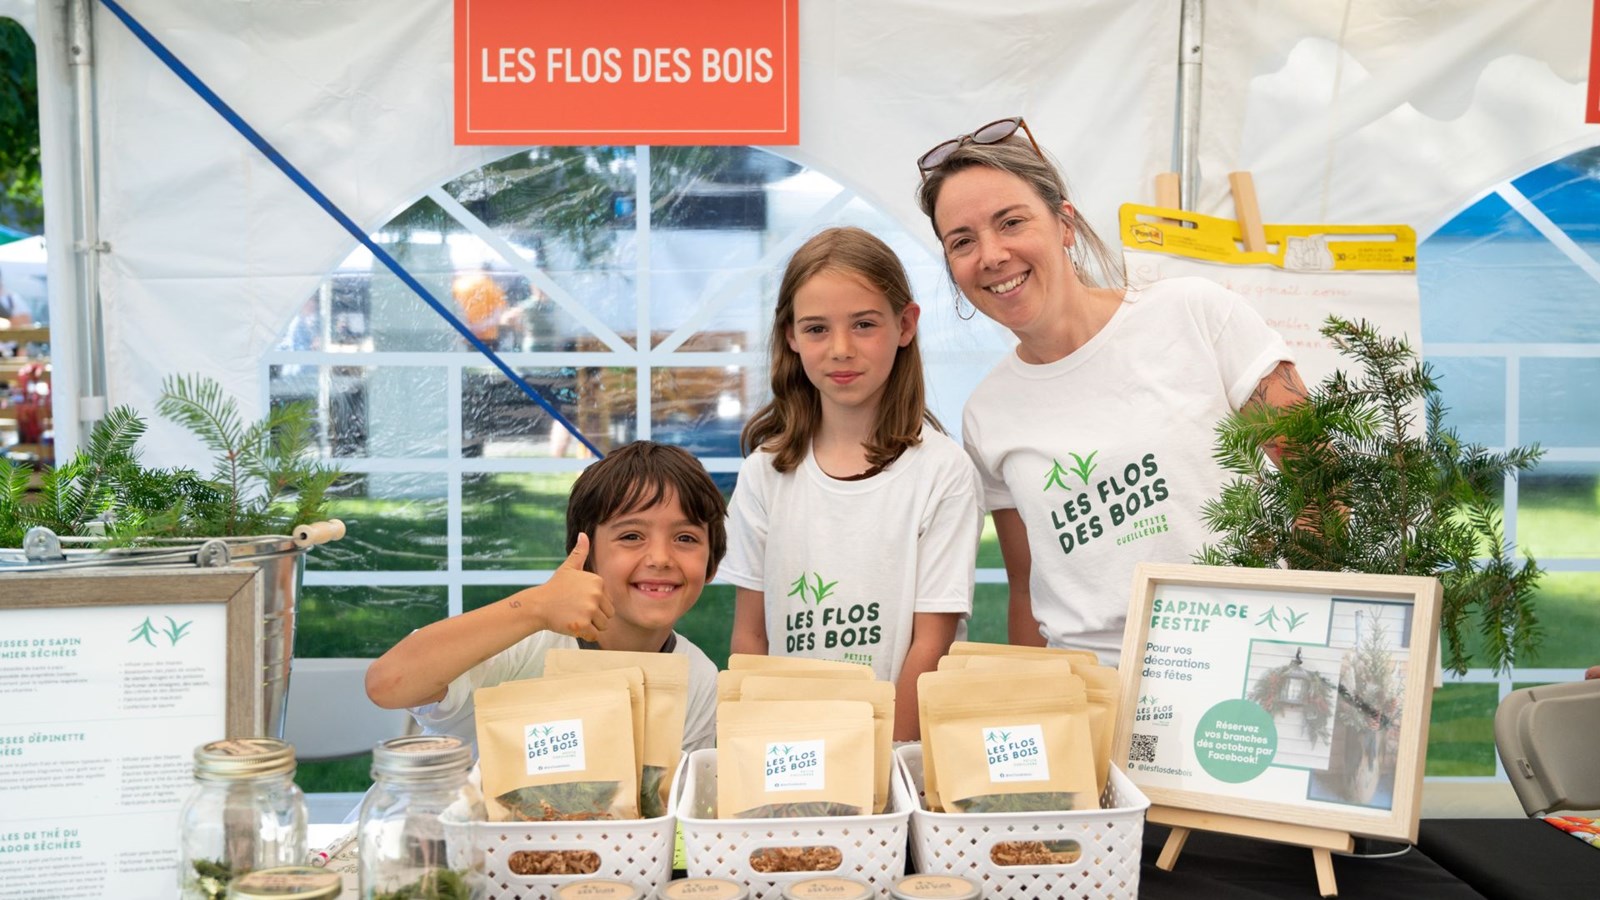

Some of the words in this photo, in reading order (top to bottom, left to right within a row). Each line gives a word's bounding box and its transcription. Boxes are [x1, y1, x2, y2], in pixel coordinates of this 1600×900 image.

[481, 47, 536, 83] LES
[547, 47, 622, 83] FLOS
[633, 47, 692, 83] DES
[702, 47, 774, 83] BOIS
[1051, 493, 1091, 530] LES
[1097, 453, 1158, 504] FLOS
[1059, 515, 1103, 555] DES
[1109, 478, 1169, 527] BOIS
[1133, 514, 1167, 529] PETITS
[1116, 524, 1169, 546] CUEILLEURS
[786, 610, 814, 631] LES
[822, 602, 880, 626] FLOS
[1153, 599, 1249, 619] SAPINAGE
[1151, 615, 1211, 632] FESTIF
[33, 639, 45, 647] DE
[49, 637, 82, 646] SAPIN
[786, 632, 815, 653] DES
[825, 625, 882, 648] BOIS
[0, 651, 27, 659] MIER
[844, 652, 873, 662] PETITS
[1146, 642, 1171, 653] Pour
[1173, 646, 1192, 655] vos
[1144, 655, 1211, 670] décorations
[1142, 668, 1161, 678] des
[1164, 669, 1193, 681] fêtes
[1153, 705, 1173, 713] FLOS
[1153, 712, 1173, 720] BOIS
[1215, 720, 1259, 733] Réservez
[528, 739, 546, 750] LES
[550, 731, 576, 744] FLOS
[1204, 731, 1221, 739] vos
[1223, 731, 1268, 744] branches
[529, 747, 548, 759] DES
[553, 739, 578, 752] BOIS
[986, 745, 1005, 755] LES
[1009, 738, 1035, 750] FLOS
[1196, 739, 1214, 748] dès
[1215, 742, 1254, 754] octobre
[1256, 747, 1273, 756] par
[766, 757, 785, 768] LES
[789, 751, 815, 762] FLOS
[989, 753, 1009, 765] DES
[1013, 746, 1039, 759] BOIS
[1208, 751, 1259, 764] Facebook!
[766, 765, 786, 776] DES
[791, 758, 817, 770] BOIS
[1138, 764, 1192, 777] @lesflosdesbois
[24, 832, 37, 840] DE
[63, 829, 79, 837] DU
